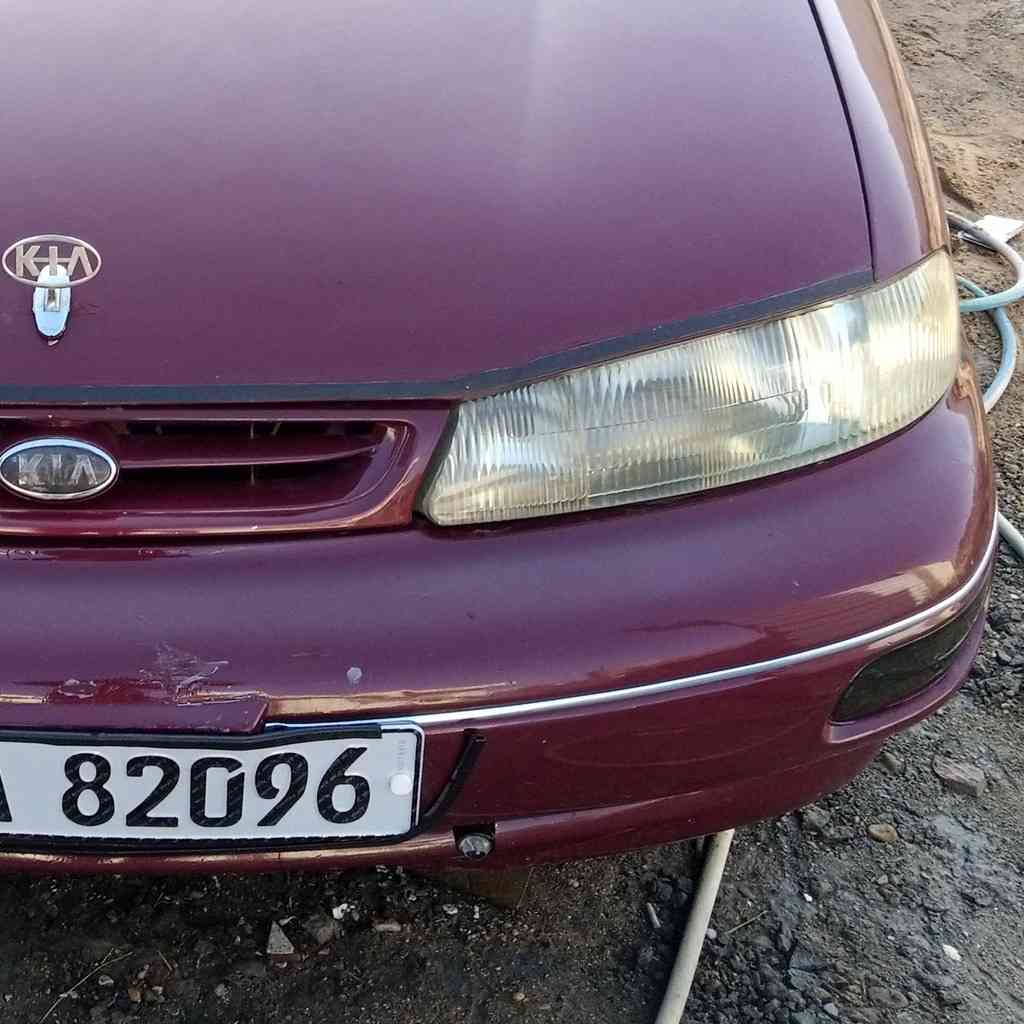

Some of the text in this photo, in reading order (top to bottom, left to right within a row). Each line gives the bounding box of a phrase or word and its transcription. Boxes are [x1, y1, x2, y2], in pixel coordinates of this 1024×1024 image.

[14, 244, 97, 278] KIA
[17, 453, 99, 486] KIA
[61, 746, 371, 828] 82096
